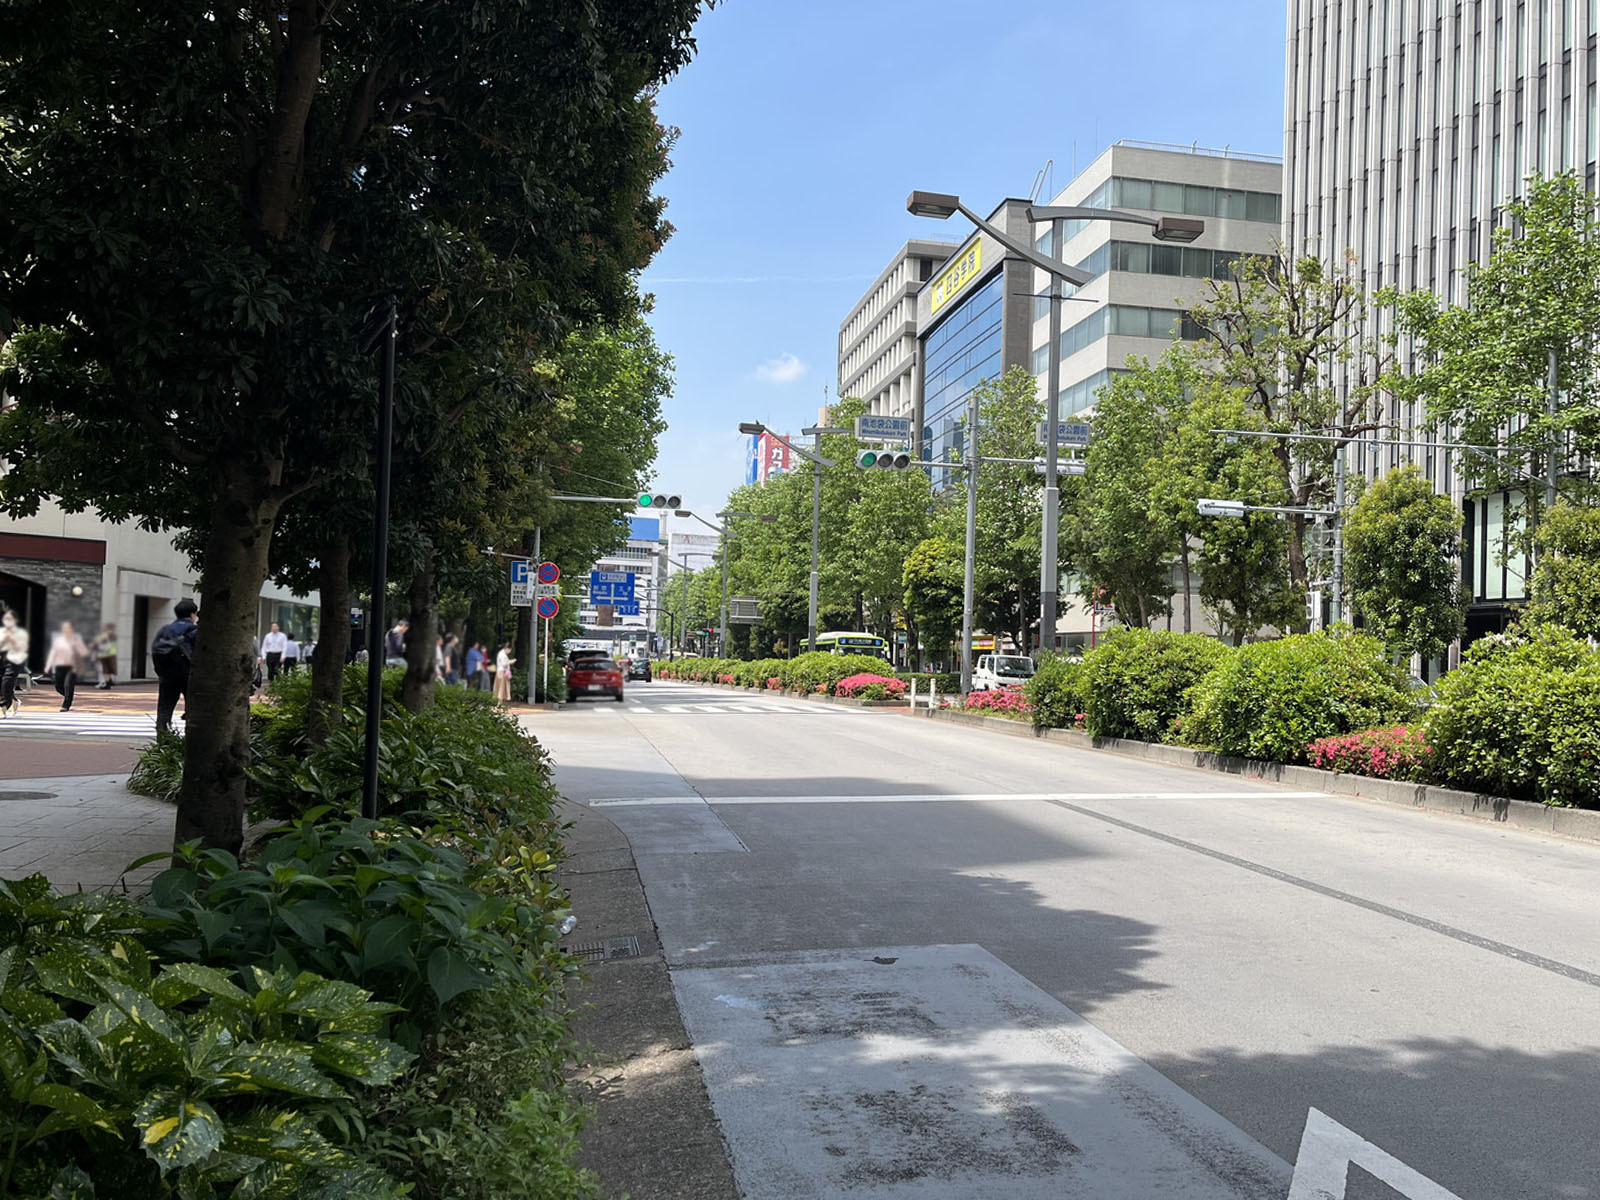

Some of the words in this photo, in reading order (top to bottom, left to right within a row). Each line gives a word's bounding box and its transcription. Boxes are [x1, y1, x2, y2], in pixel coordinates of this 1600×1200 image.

[862, 418, 907, 430] 南池袋公園前
[1043, 423, 1087, 435] 南袋公園前
